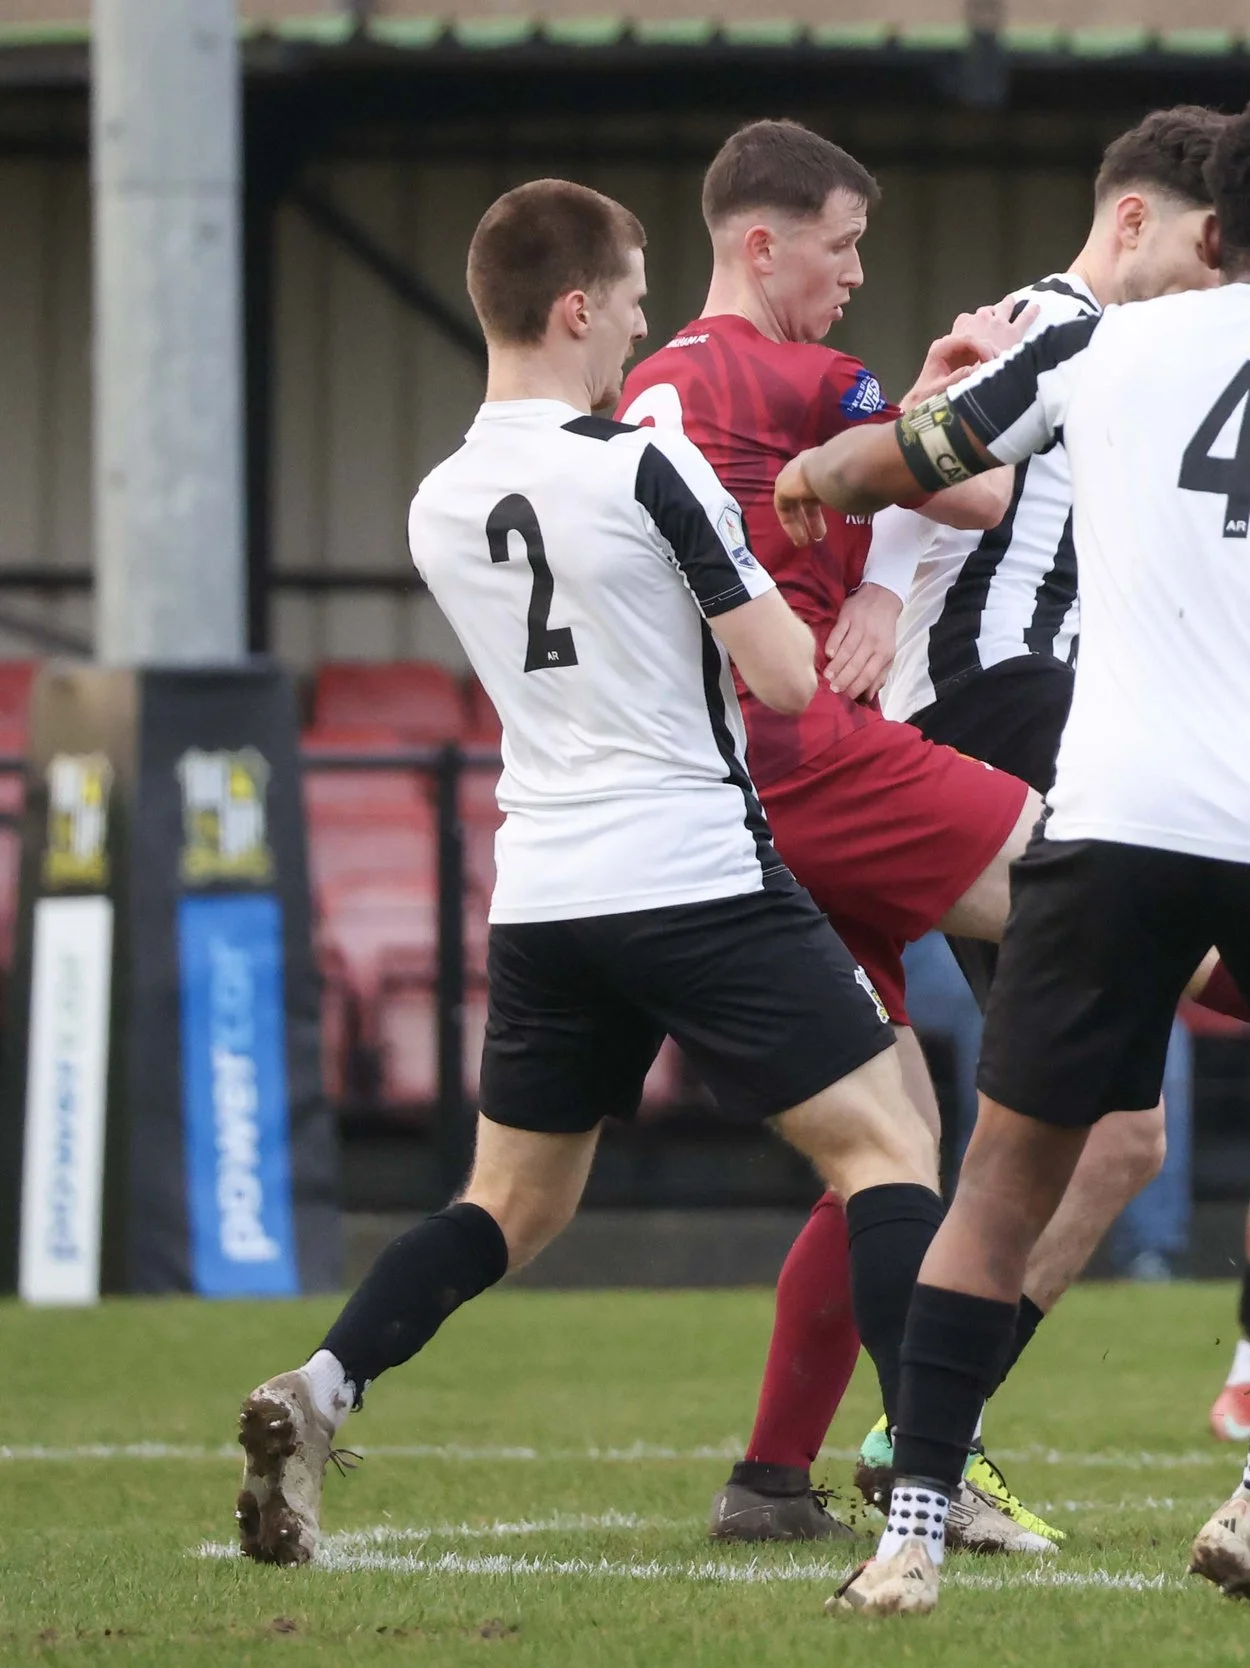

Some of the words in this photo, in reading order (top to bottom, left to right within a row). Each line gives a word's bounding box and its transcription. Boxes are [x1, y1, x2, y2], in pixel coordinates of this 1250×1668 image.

[1225, 518, 1247, 532] AR
[485, 493, 579, 673] 2
[547, 650, 560, 661] AR
